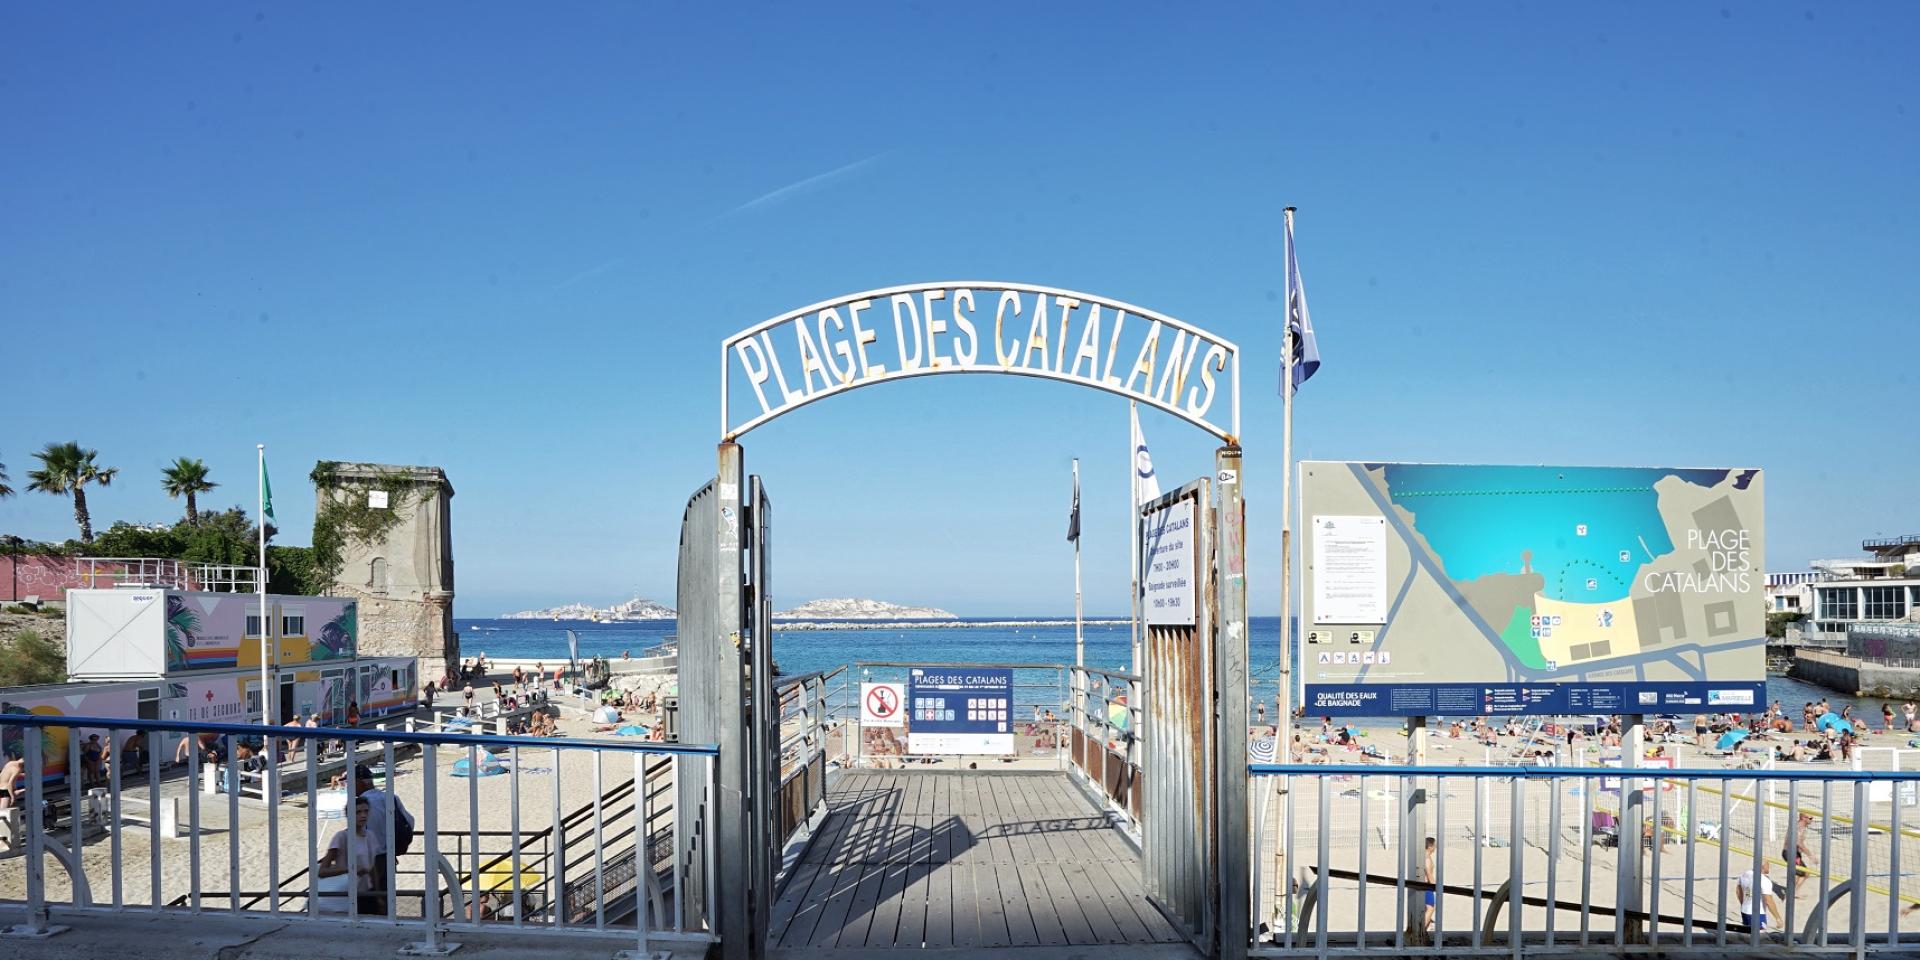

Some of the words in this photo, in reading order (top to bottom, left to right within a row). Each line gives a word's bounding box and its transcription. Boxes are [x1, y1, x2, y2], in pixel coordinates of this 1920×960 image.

[736, 300, 887, 414] PLAGE
[891, 288, 979, 371] DES
[995, 290, 1227, 419] CATALANS
[1166, 518, 1189, 533] CATALANS
[1169, 542, 1175, 551] du
[1175, 540, 1184, 550] site
[1688, 529, 1750, 550] PLAGE
[1712, 551, 1751, 572] DES
[1148, 580, 1165, 592] Baignade
[1165, 577, 1187, 589] surveillée
[1644, 572, 1751, 593] CATALANS
[915, 676, 944, 685] PLAGES
[947, 676, 963, 685] DES
[966, 676, 1007, 685] CATALANS
[1317, 691, 1345, 700] QUALITÉ
